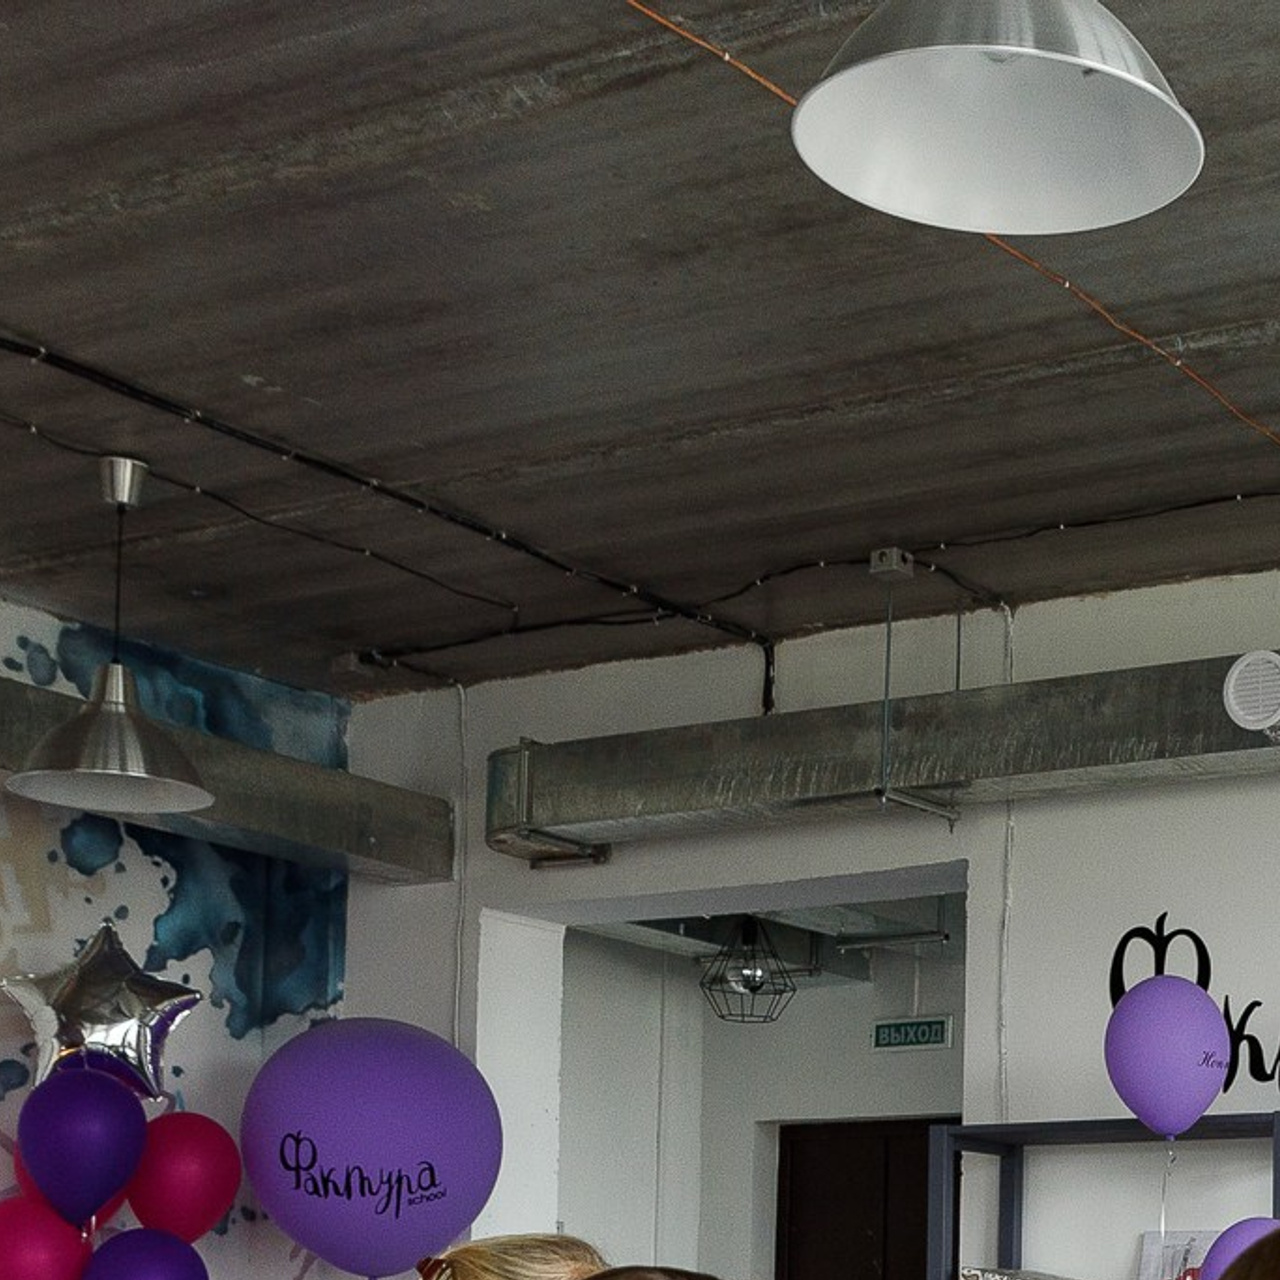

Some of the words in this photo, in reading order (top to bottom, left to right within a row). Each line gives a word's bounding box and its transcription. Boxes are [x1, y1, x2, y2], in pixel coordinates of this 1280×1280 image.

[878, 1024, 942, 1045] ВЫХОД
[279, 1130, 442, 1219] Фактура
[407, 1188, 448, 1206] school
